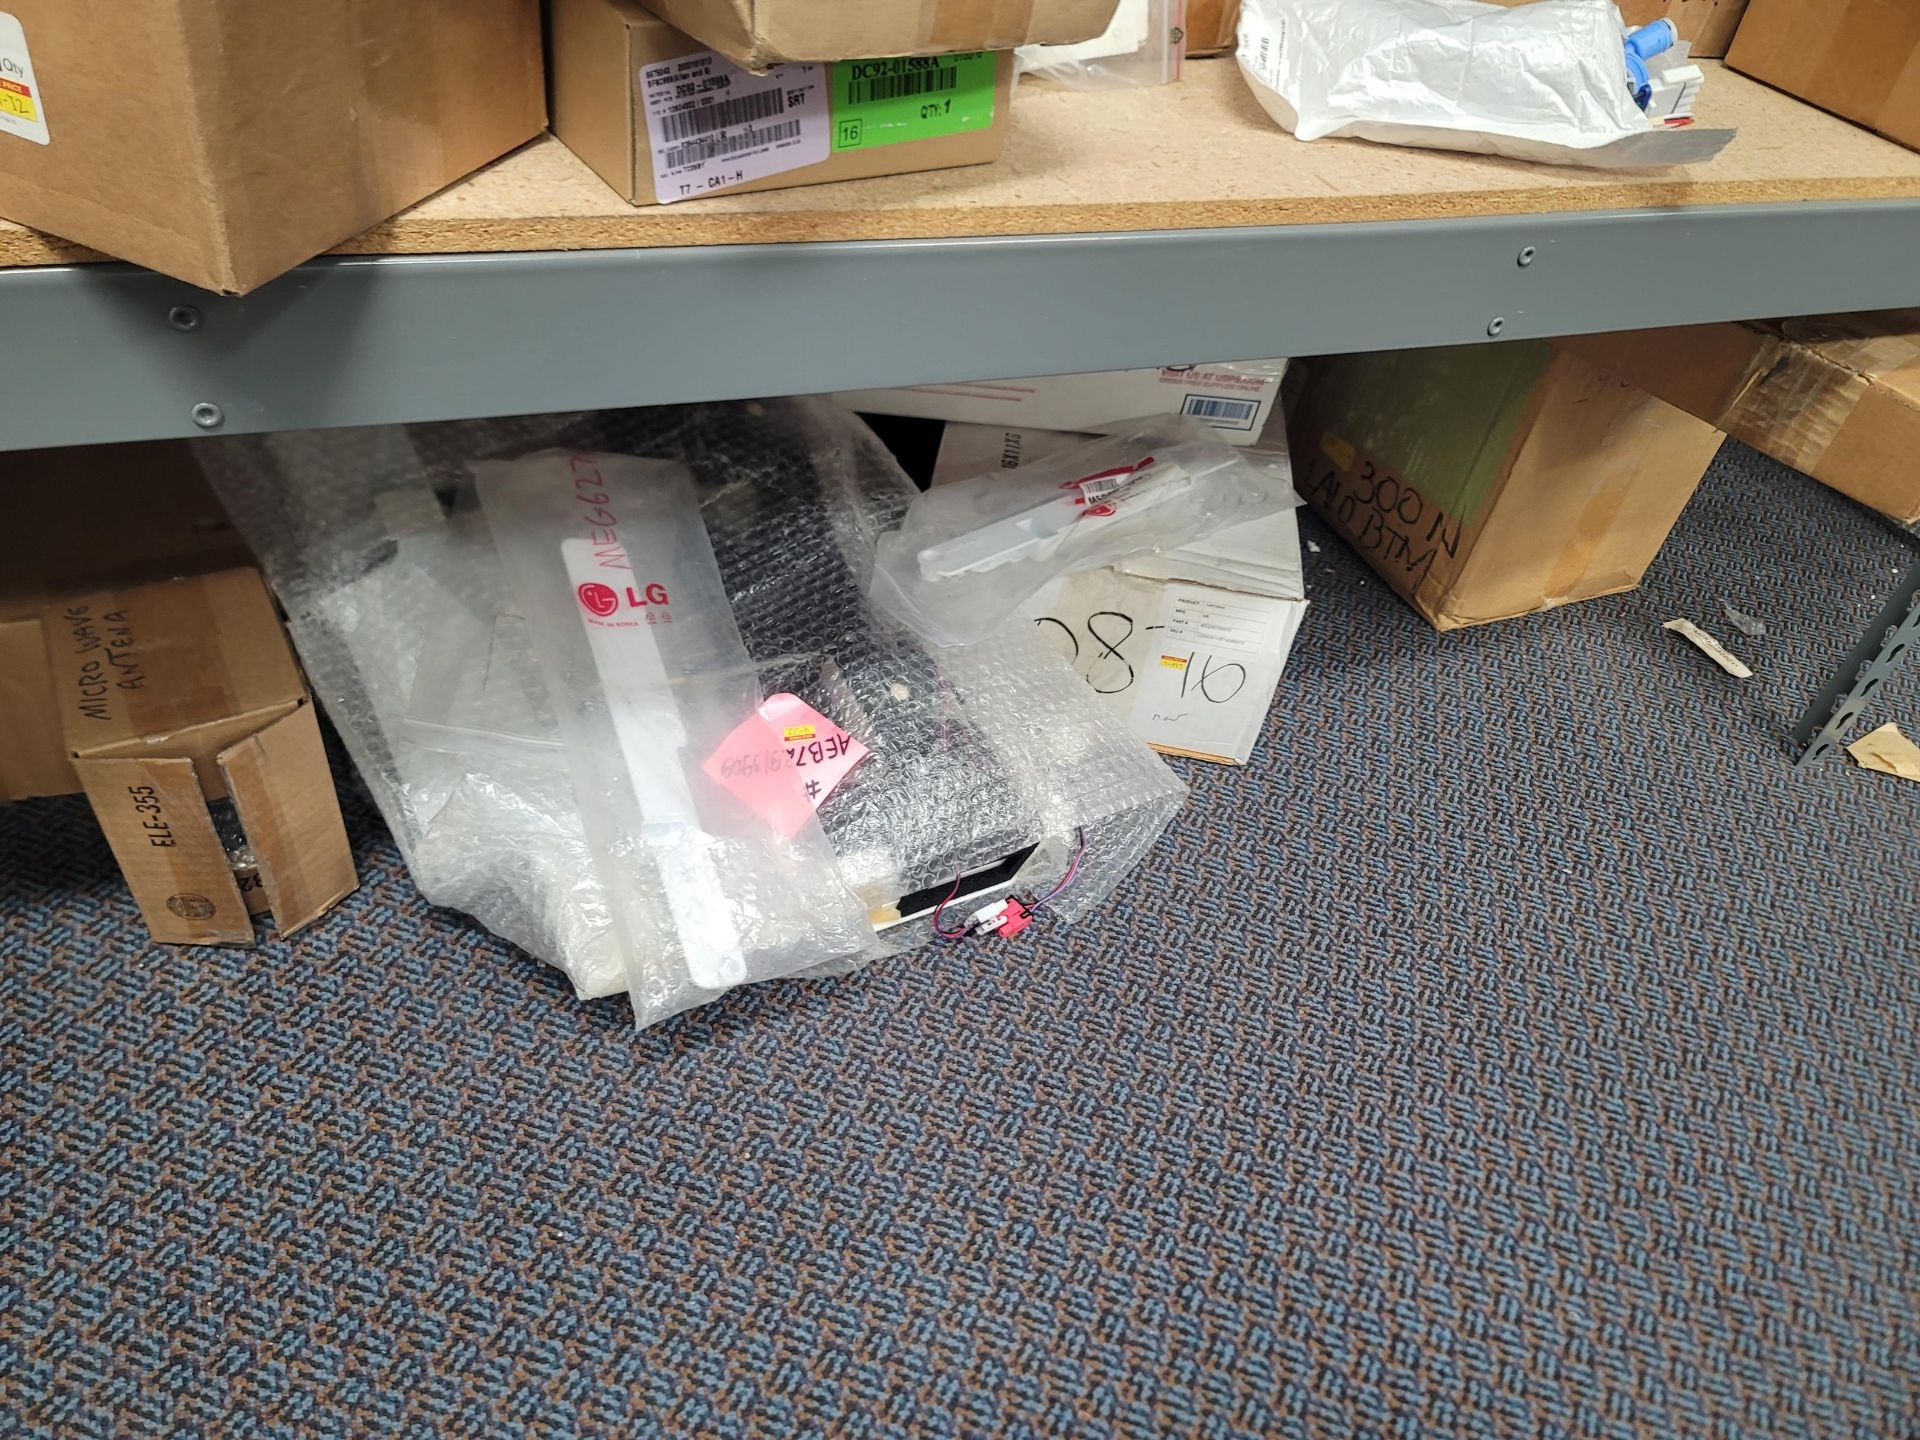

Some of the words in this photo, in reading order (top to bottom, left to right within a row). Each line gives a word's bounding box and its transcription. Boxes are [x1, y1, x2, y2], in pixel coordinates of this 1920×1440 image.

[3, 58, 24, 78] Qty
[851, 56, 940, 80] DC92-01588A
[787, 93, 805, 107] SRT
[921, 105, 942, 119] QTY:
[944, 98, 951, 115] 1
[843, 125, 859, 141] 16
[680, 184, 691, 195] T7
[1187, 370, 1200, 380] US
[1202, 372, 1214, 381] AT
[1354, 461, 1423, 524] 300
[1426, 503, 1466, 559] N
[626, 583, 669, 608] LG
[1178, 598, 1200, 606] PRODUCT
[78, 661, 112, 720] MICRO
[128, 786, 176, 848] ELE-355
